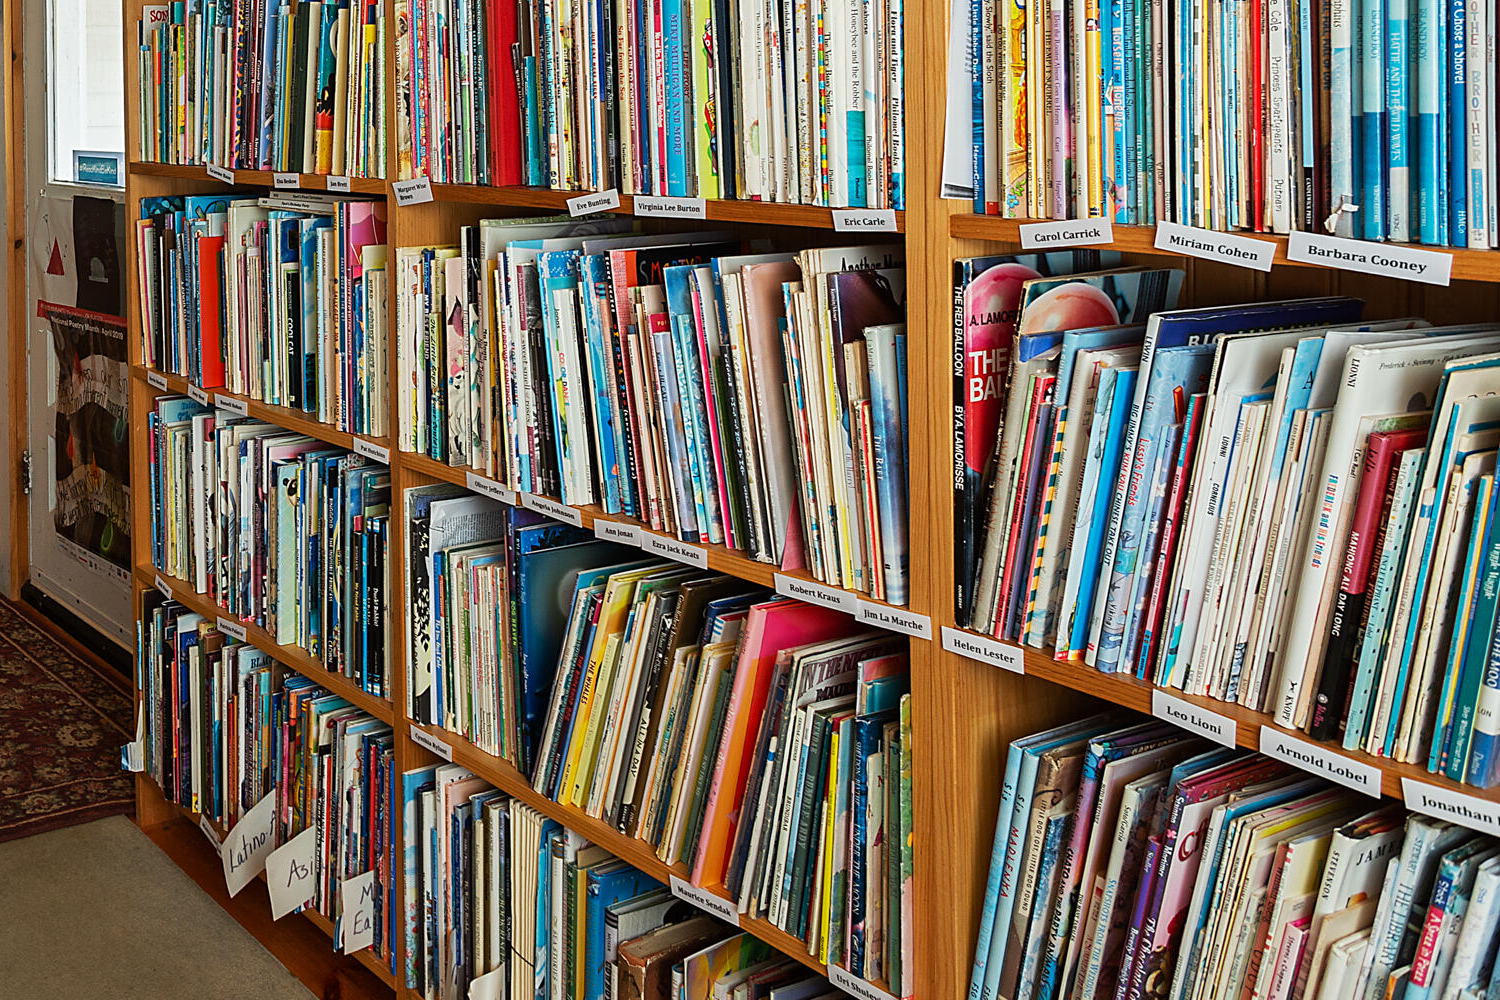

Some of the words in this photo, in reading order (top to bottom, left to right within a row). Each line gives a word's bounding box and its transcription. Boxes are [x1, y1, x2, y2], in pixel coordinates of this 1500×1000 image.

[1454, 9, 1466, 34] Chose
[1455, 49, 1467, 85] Shovel
[576, 202, 587, 210] Eve
[587, 198, 611, 210] Bunting
[638, 203, 666, 213] Virginia
[667, 203, 676, 211] Lee
[677, 203, 701, 212] Burton
[844, 217, 862, 226] Eric
[862, 217, 885, 226] Carle
[1034, 232, 1060, 243] Carol
[1062, 228, 1101, 241] Carrick
[1169, 234, 1214, 253] Miriam
[1217, 244, 1259, 261] Cohen
[1307, 244, 1367, 263] Barbara
[1370, 254, 1428, 274] Cooney
[954, 285, 963, 305] THE
[954, 306, 963, 326] RED
[67, 318, 84, 331] Poetry
[101, 325, 112, 337] April
[112, 329, 124, 340] 2019
[954, 327, 963, 377] BALLOON
[968, 347, 1008, 377] THE
[955, 405, 964, 419] BY
[955, 431, 964, 490] LAMORISSE
[532, 500, 550, 512] Angela
[551, 506, 575, 520] Johnson
[605, 527, 618, 535] Ann
[618, 529, 633, 539] Jonas
[652, 540, 668, 550] Ezra
[668, 543, 681, 555] Jack
[681, 547, 699, 560] Keats
[789, 584, 815, 597] Robert
[816, 590, 840, 604] Kraus
[863, 609, 878, 620] Jim
[879, 613, 890, 623] La
[891, 616, 923, 630] Marche
[953, 639, 982, 654] Helen
[983, 646, 1015, 664] Lester
[1166, 705, 1188, 722] Leo
[1190, 713, 1222, 735] Lioni
[1276, 743, 1323, 769] Arnold
[1327, 763, 1368, 785] Lobel
[1422, 795, 1492, 823] Jonathan
[1000, 826, 1020, 898] MADLENKA
[677, 885, 704, 904] Maurice
[705, 898, 732, 917] Sendak
[836, 974, 850, 986] Uri
